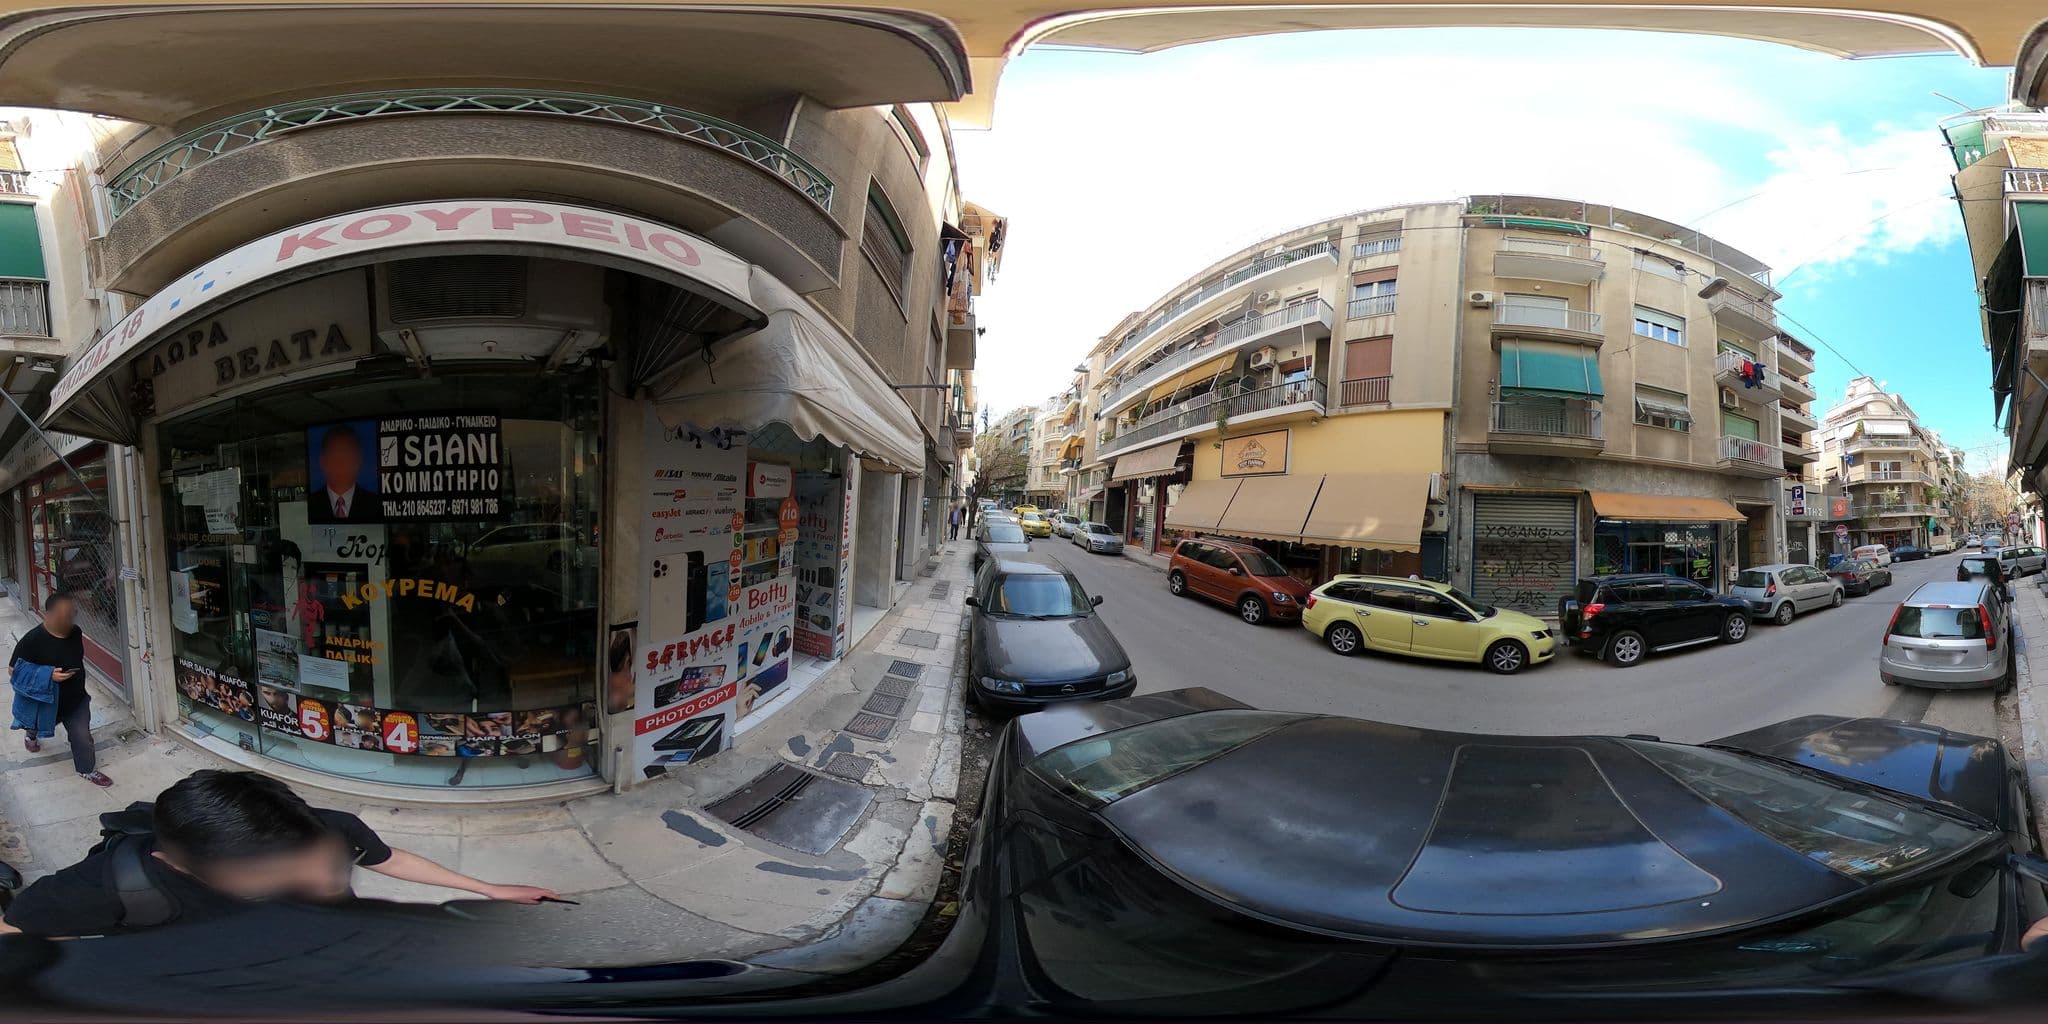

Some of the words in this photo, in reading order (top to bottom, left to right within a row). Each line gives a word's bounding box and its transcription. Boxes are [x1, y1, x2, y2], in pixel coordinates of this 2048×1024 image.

[276, 207, 701, 266] ΚΟΥΡΕΙΟ
[119, 308, 145, 346] 18
[213, 315, 352, 385] ΒΕΑΤΑ
[380, 419, 413, 432] ΑΝΔΡΙΚΟ
[418, 416, 450, 430] ΠΑΙΔΙΚΟ
[456, 415, 497, 428] ΓΥΝΑΙΚΕΙΟ
[404, 433, 498, 467] SHANI
[381, 469, 499, 494] ΚΟΜΜΩΤΗΡΙΟ
[1794, 488, 1801, 499] P
[402, 501, 416, 516] 210
[652, 508, 681, 519] easyJet
[340, 578, 475, 614] ΚΟΥΡΕΜΑ
[748, 583, 788, 610] Betty
[646, 624, 736, 674] SERVICE
[179, 658, 194, 670] HAIR
[193, 663, 216, 679] SALON
[645, 704, 695, 729] PHOTO
[698, 687, 731, 709] COPY
[467, 735, 498, 743] HAIR
[499, 731, 542, 742] SALON
